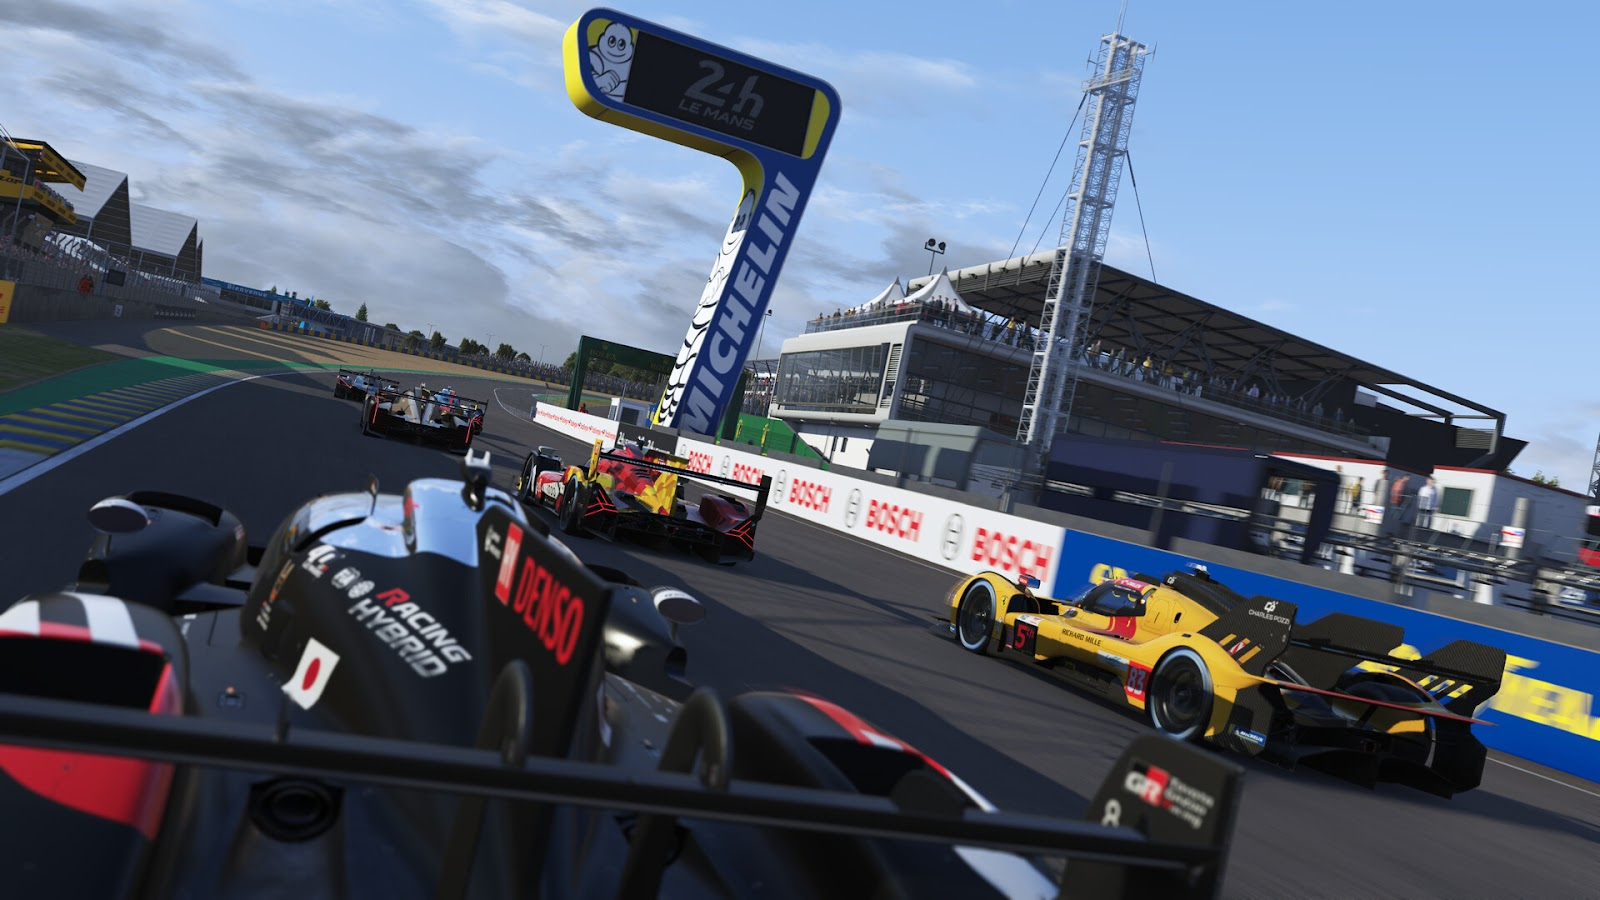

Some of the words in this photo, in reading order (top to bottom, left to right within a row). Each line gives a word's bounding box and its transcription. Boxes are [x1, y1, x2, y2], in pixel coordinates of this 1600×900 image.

[678, 98, 702, 114] LE
[703, 106, 756, 131] MANS
[226, 283, 268, 298] Bienvenue
[681, 171, 800, 435] MICHELIN
[687, 450, 713, 475] BOSCH
[731, 463, 765, 485] BOSCH
[788, 478, 832, 513] BOSCH
[865, 499, 924, 542] BOSCH
[971, 527, 1054, 582] BOSCH
[376, 588, 472, 663] RACING
[513, 556, 584, 665] DENSO
[1248, 609, 1273, 621] CHARLES
[348, 598, 447, 678] HYBRID
[1061, 628, 1085, 641] RICHARD
[1085, 634, 1101, 646] MILLE
[1127, 667, 1147, 695] 83
[1124, 770, 1163, 806] GR
